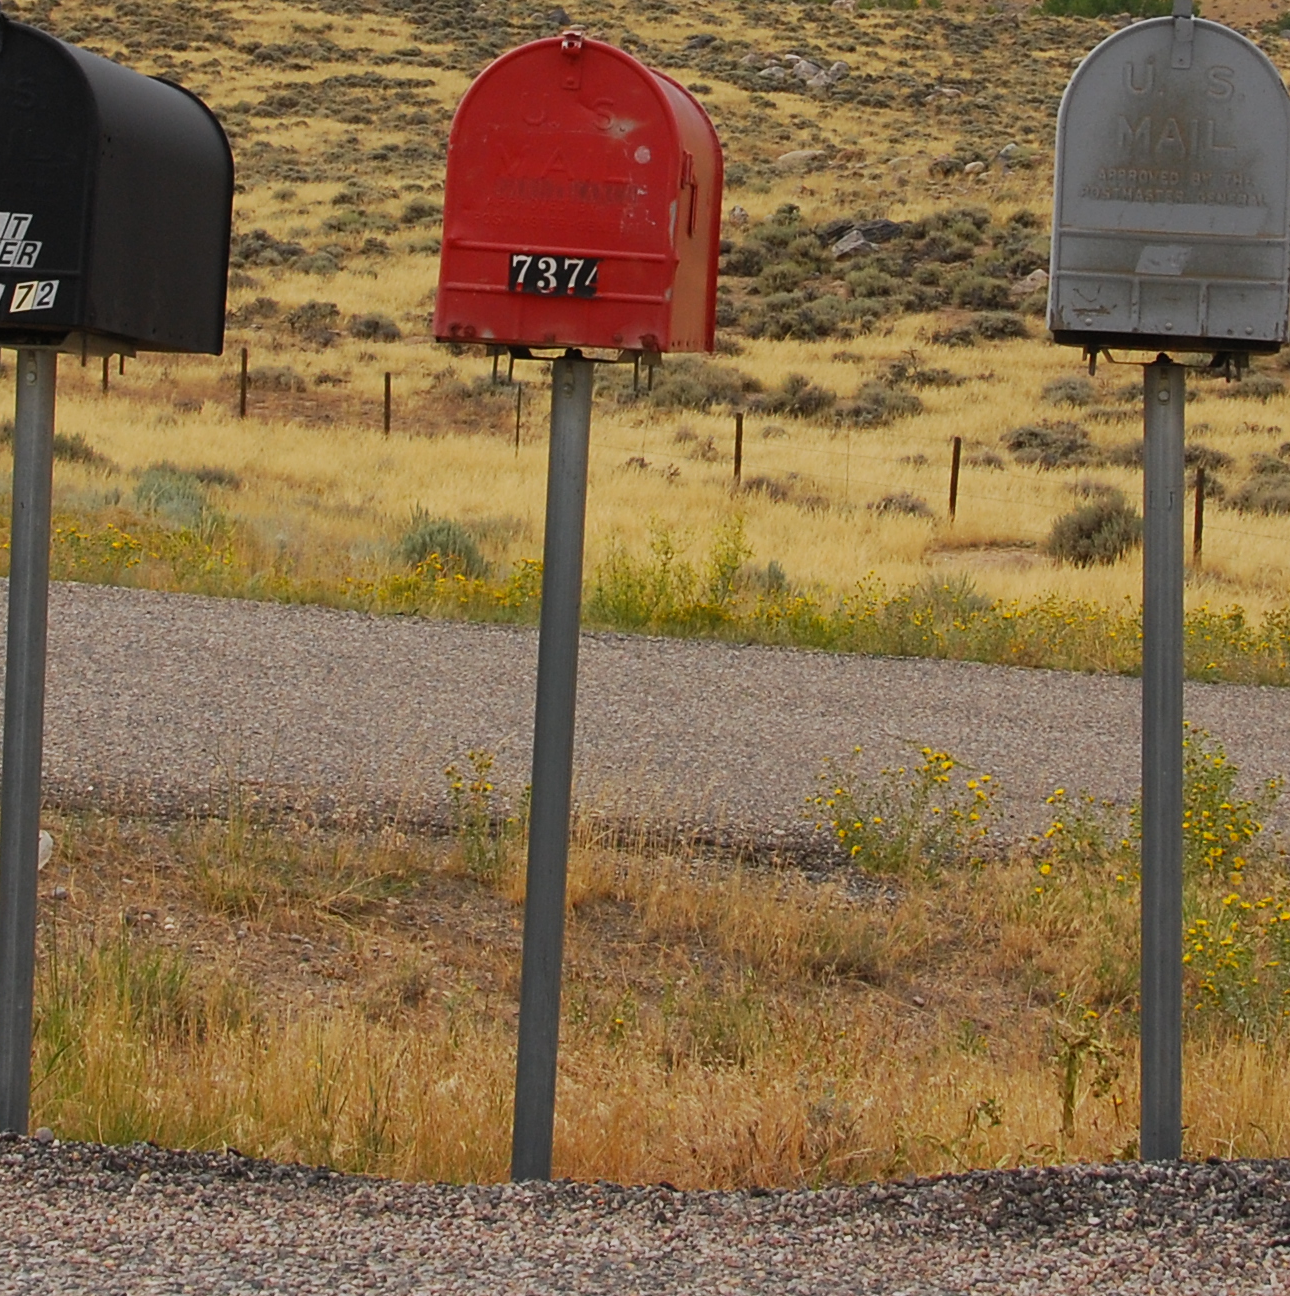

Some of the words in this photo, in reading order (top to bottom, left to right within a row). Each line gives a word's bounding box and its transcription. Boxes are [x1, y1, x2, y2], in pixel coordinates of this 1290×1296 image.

[1117, 115, 1237, 157] MAIL
[1098, 169, 1179, 185] APPROVED
[1191, 172, 1213, 186] BY
[1079, 185, 1184, 202] POSTMASTER
[1198, 191, 1269, 208] GENERAL
[14, 281, 54, 309] 72
